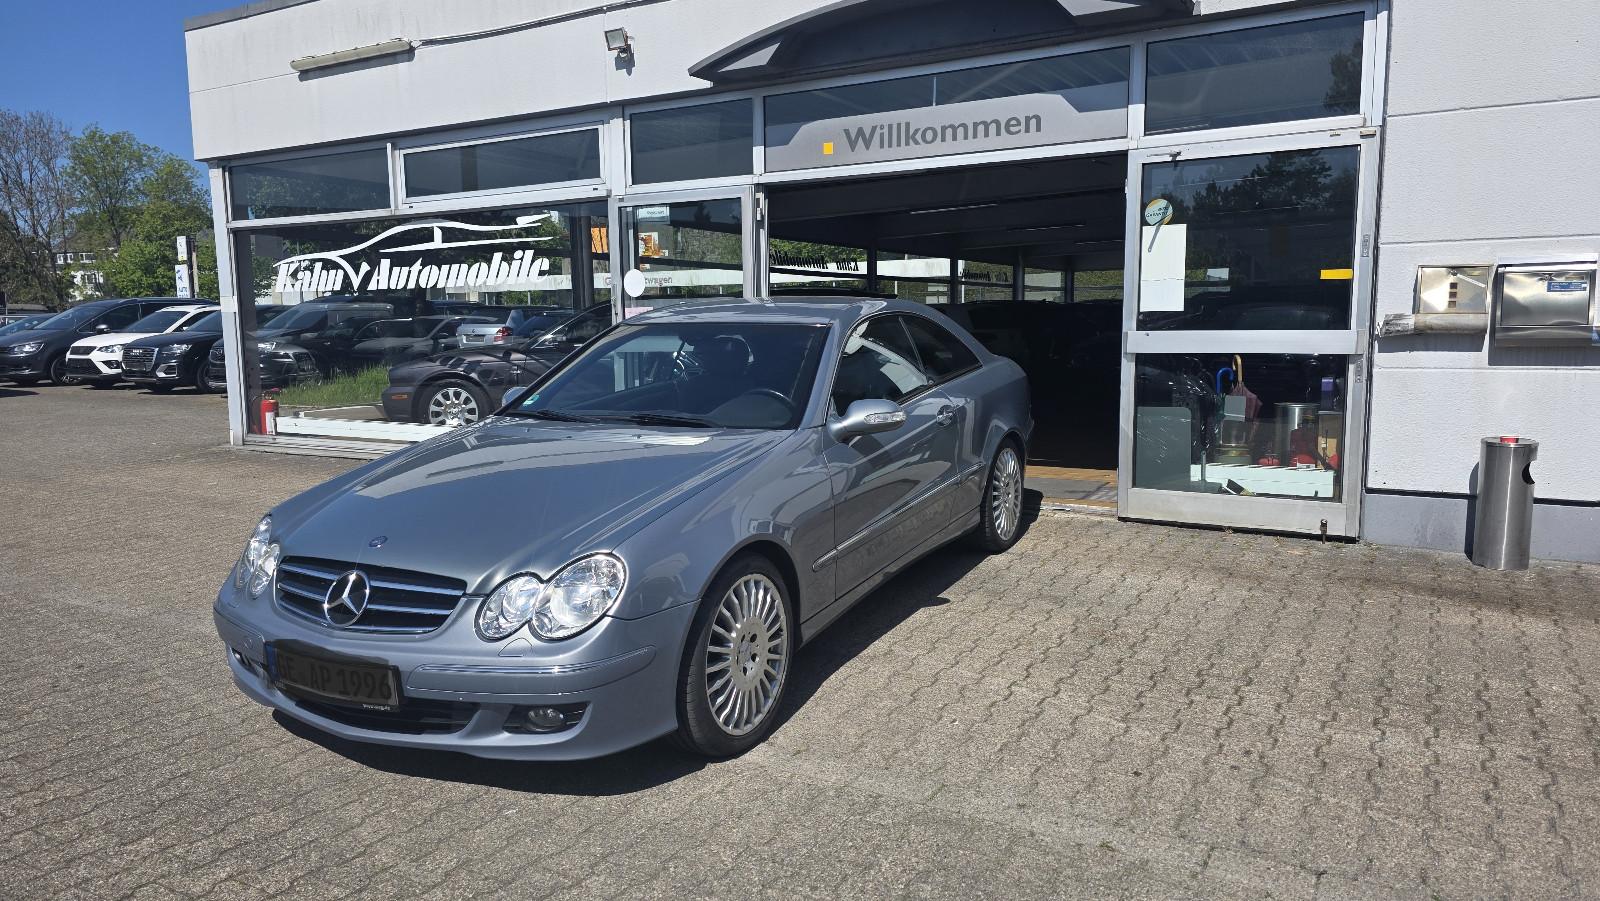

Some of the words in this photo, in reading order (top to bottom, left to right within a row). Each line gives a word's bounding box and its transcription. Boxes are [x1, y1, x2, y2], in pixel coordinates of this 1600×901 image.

[843, 113, 1042, 153] Willkommen
[366, 249, 549, 291] Automobile
[309, 663, 330, 690] AP
[336, 668, 393, 699] 1996
